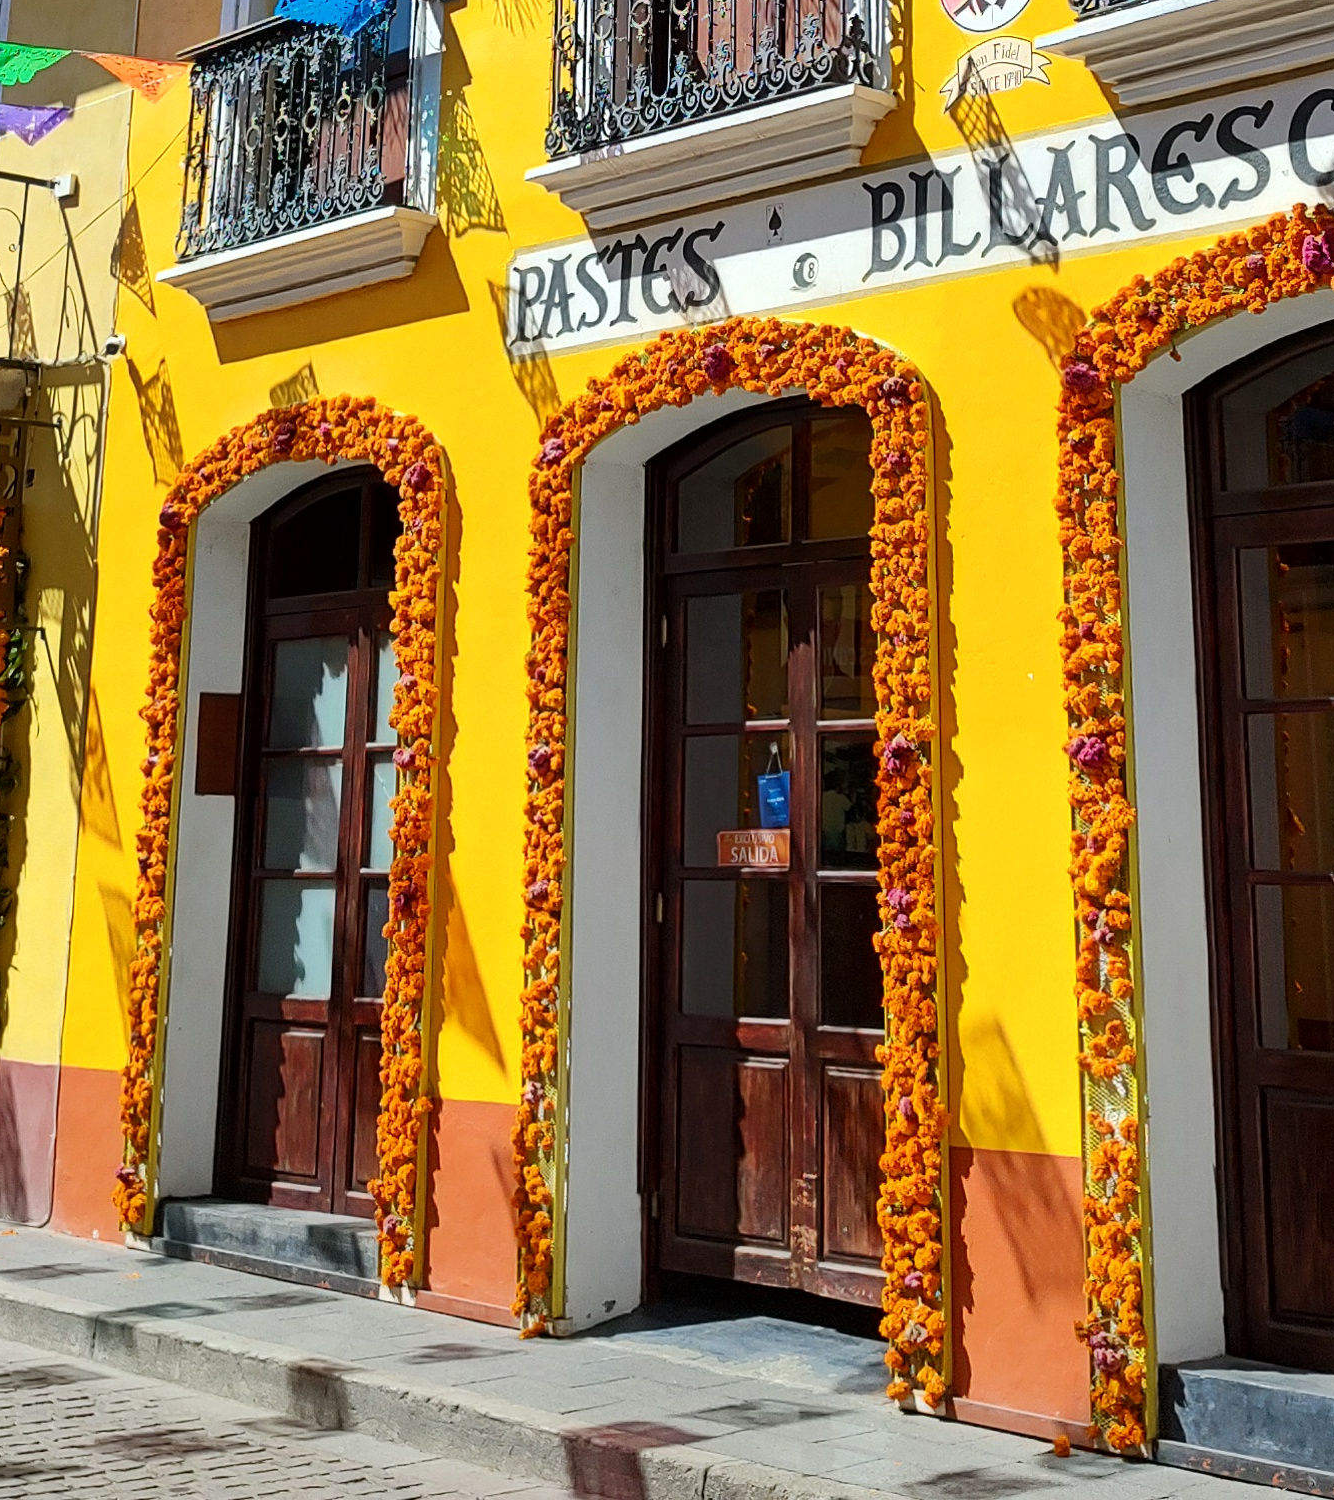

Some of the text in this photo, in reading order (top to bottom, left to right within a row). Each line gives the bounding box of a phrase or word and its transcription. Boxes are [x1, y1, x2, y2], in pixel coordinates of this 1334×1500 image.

[993, 42, 1020, 61] Fidel
[508, 220, 725, 347] PASTES
[861, 103, 1271, 278] BILLARES
[731, 846, 779, 863] SALIDA
